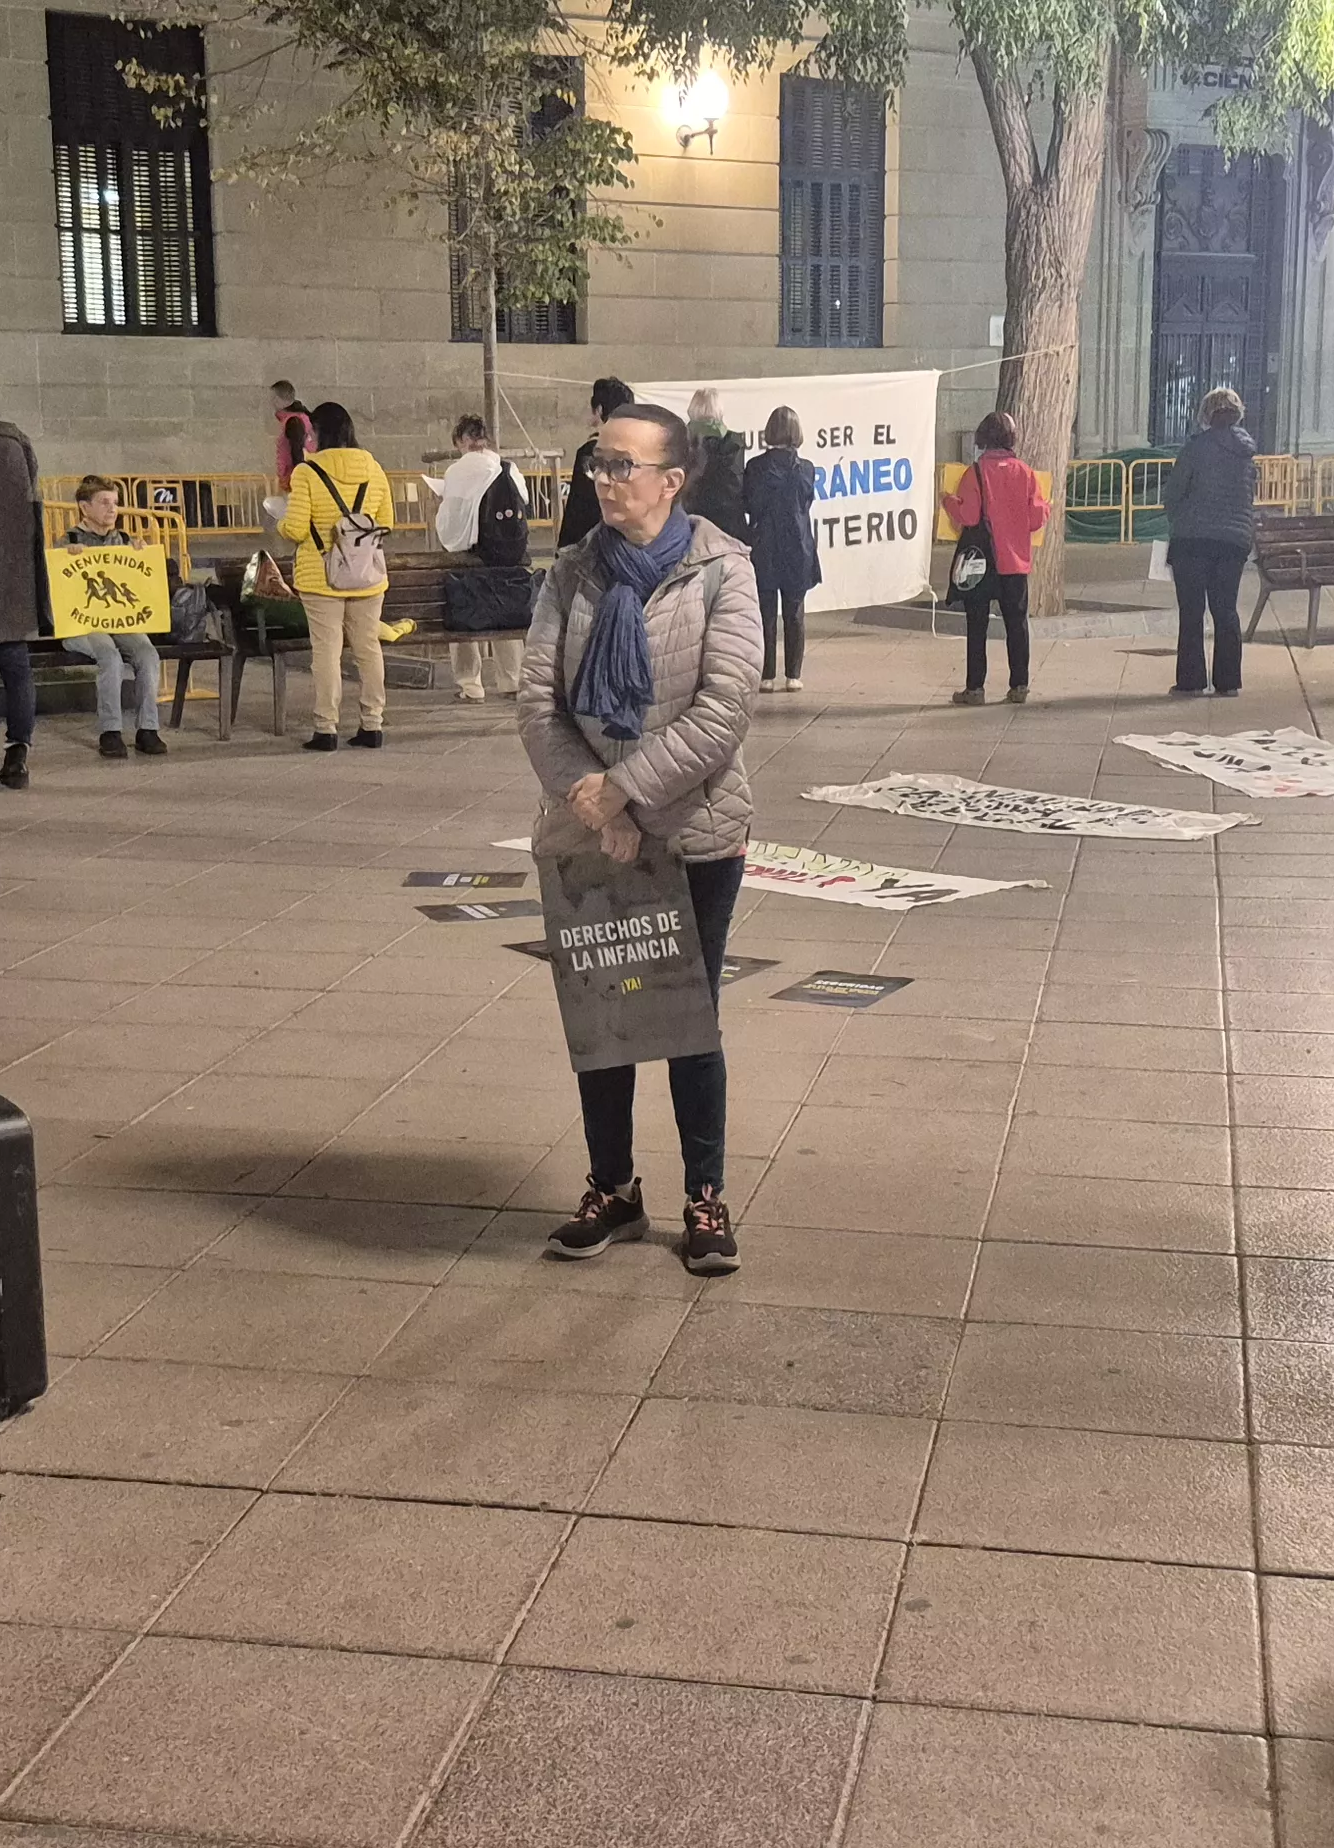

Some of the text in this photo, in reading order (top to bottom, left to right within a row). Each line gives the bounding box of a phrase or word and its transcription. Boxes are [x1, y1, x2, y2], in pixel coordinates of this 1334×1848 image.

[817, 426, 854, 448] SER
[873, 424, 896, 445] EL
[814, 457, 913, 500] RÁNEO
[814, 509, 918, 549] TERIO
[62, 553, 153, 578] BIENVENIDAS
[70, 606, 153, 629] REFUGIADAS
[560, 910, 682, 949] DERECHOS DE
[571, 936, 680, 972] LA INFANCIA
[621, 977, 643, 995] ¡YA!
